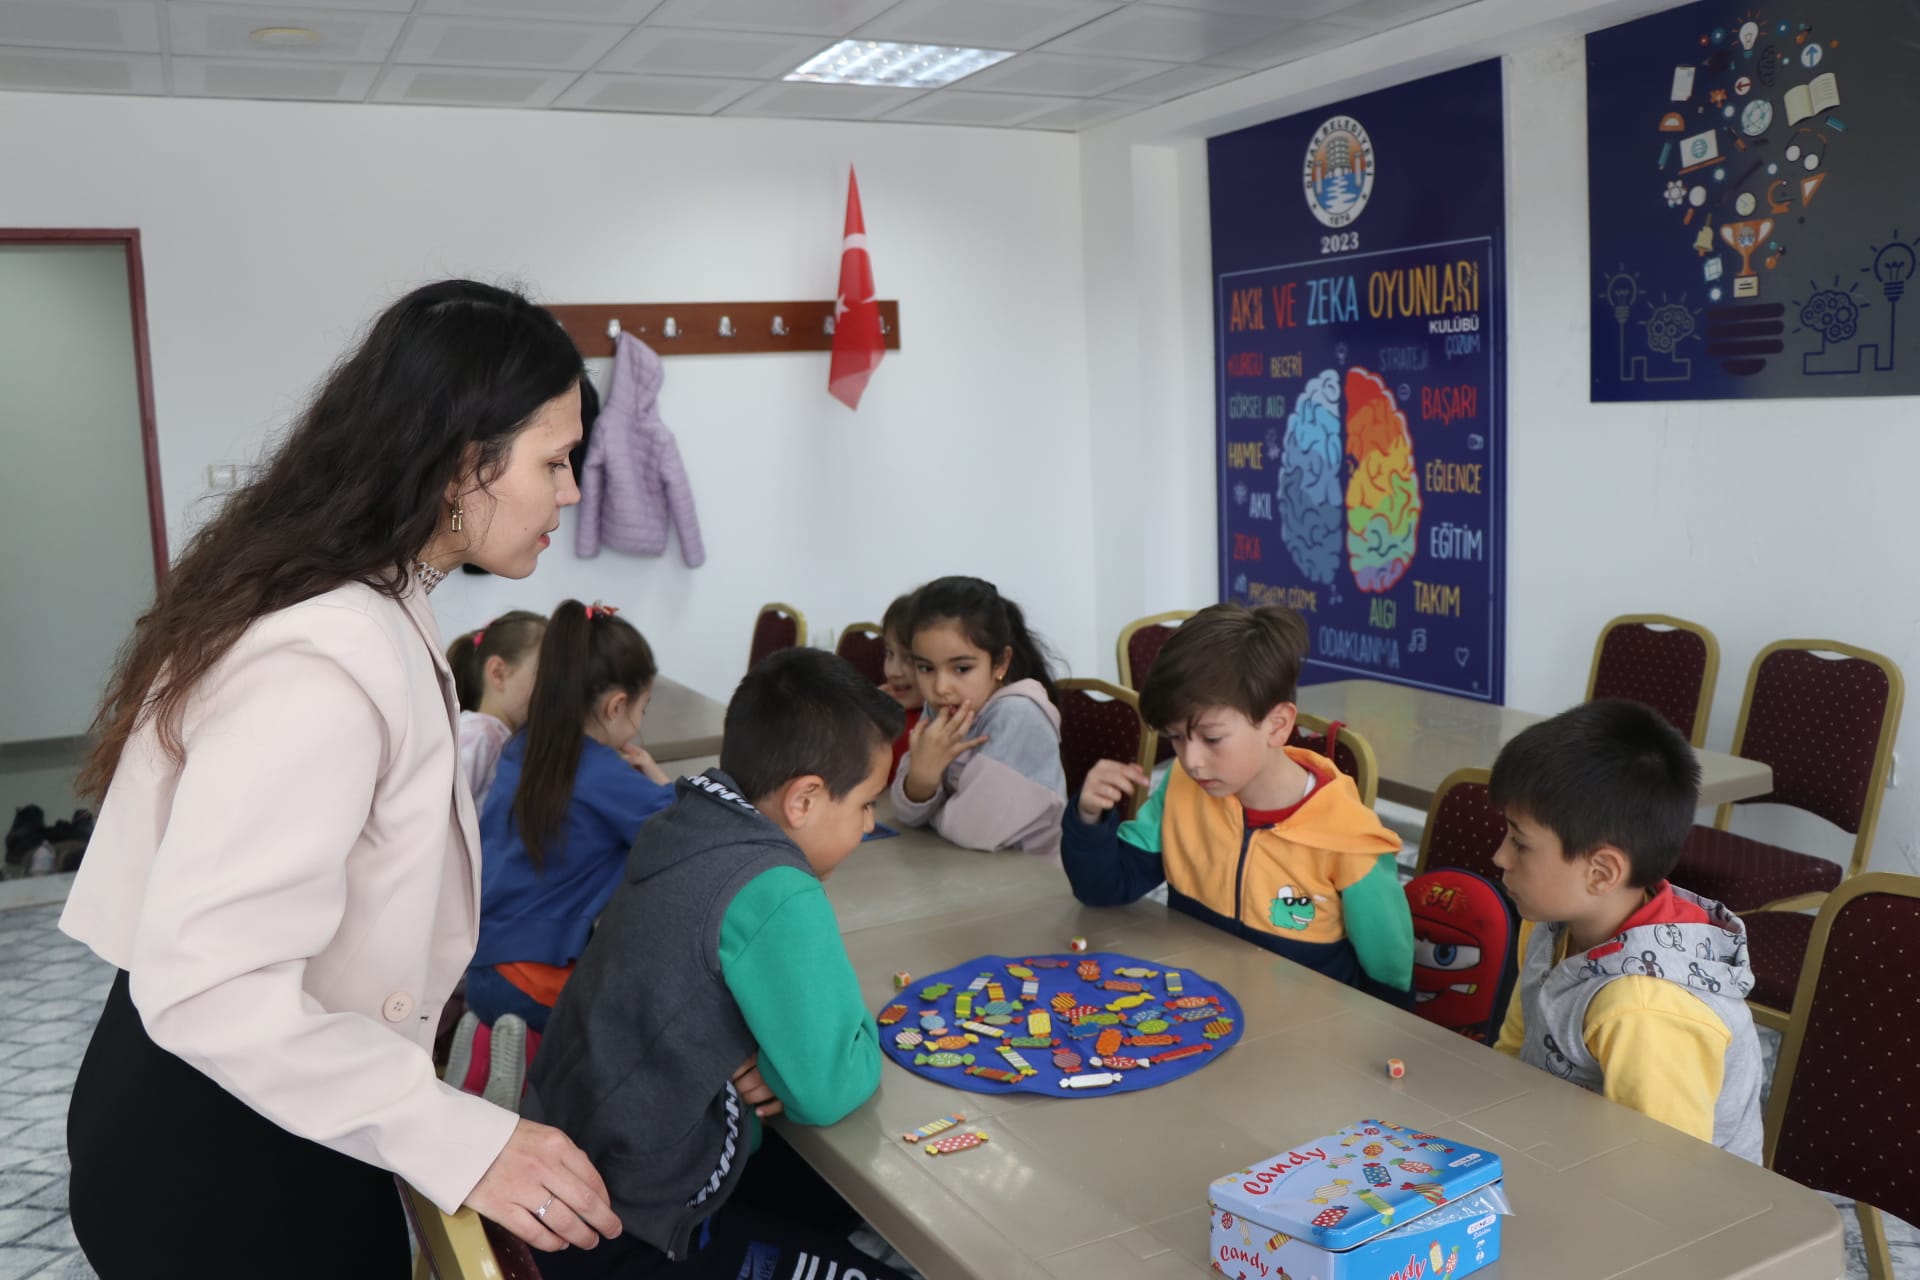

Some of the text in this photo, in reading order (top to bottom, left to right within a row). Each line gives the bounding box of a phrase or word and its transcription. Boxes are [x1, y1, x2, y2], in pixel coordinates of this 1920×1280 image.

[1321, 231, 1360, 254] 2023
[1272, 282, 1297, 329] VE
[1306, 275, 1360, 326] ZEKA
[1368, 261, 1479, 319] OYUNLARI
[1428, 315, 1479, 334] KULÜBÜ
[1421, 384, 1477, 426] BAŞARI
[1228, 441, 1264, 470] HAMLE
[1425, 459, 1482, 494] EĞLENCE
[1248, 491, 1272, 521] AKIL
[1233, 532, 1261, 561] ZEKA
[1430, 521, 1483, 561] EĞİTİM
[1369, 597, 1397, 630] ALGI
[1413, 580, 1461, 617] TAKIM
[1318, 625, 1400, 671] ODAKLANMA
[1243, 1147, 1328, 1196] Candy
[1220, 1244, 1269, 1278] Candy
